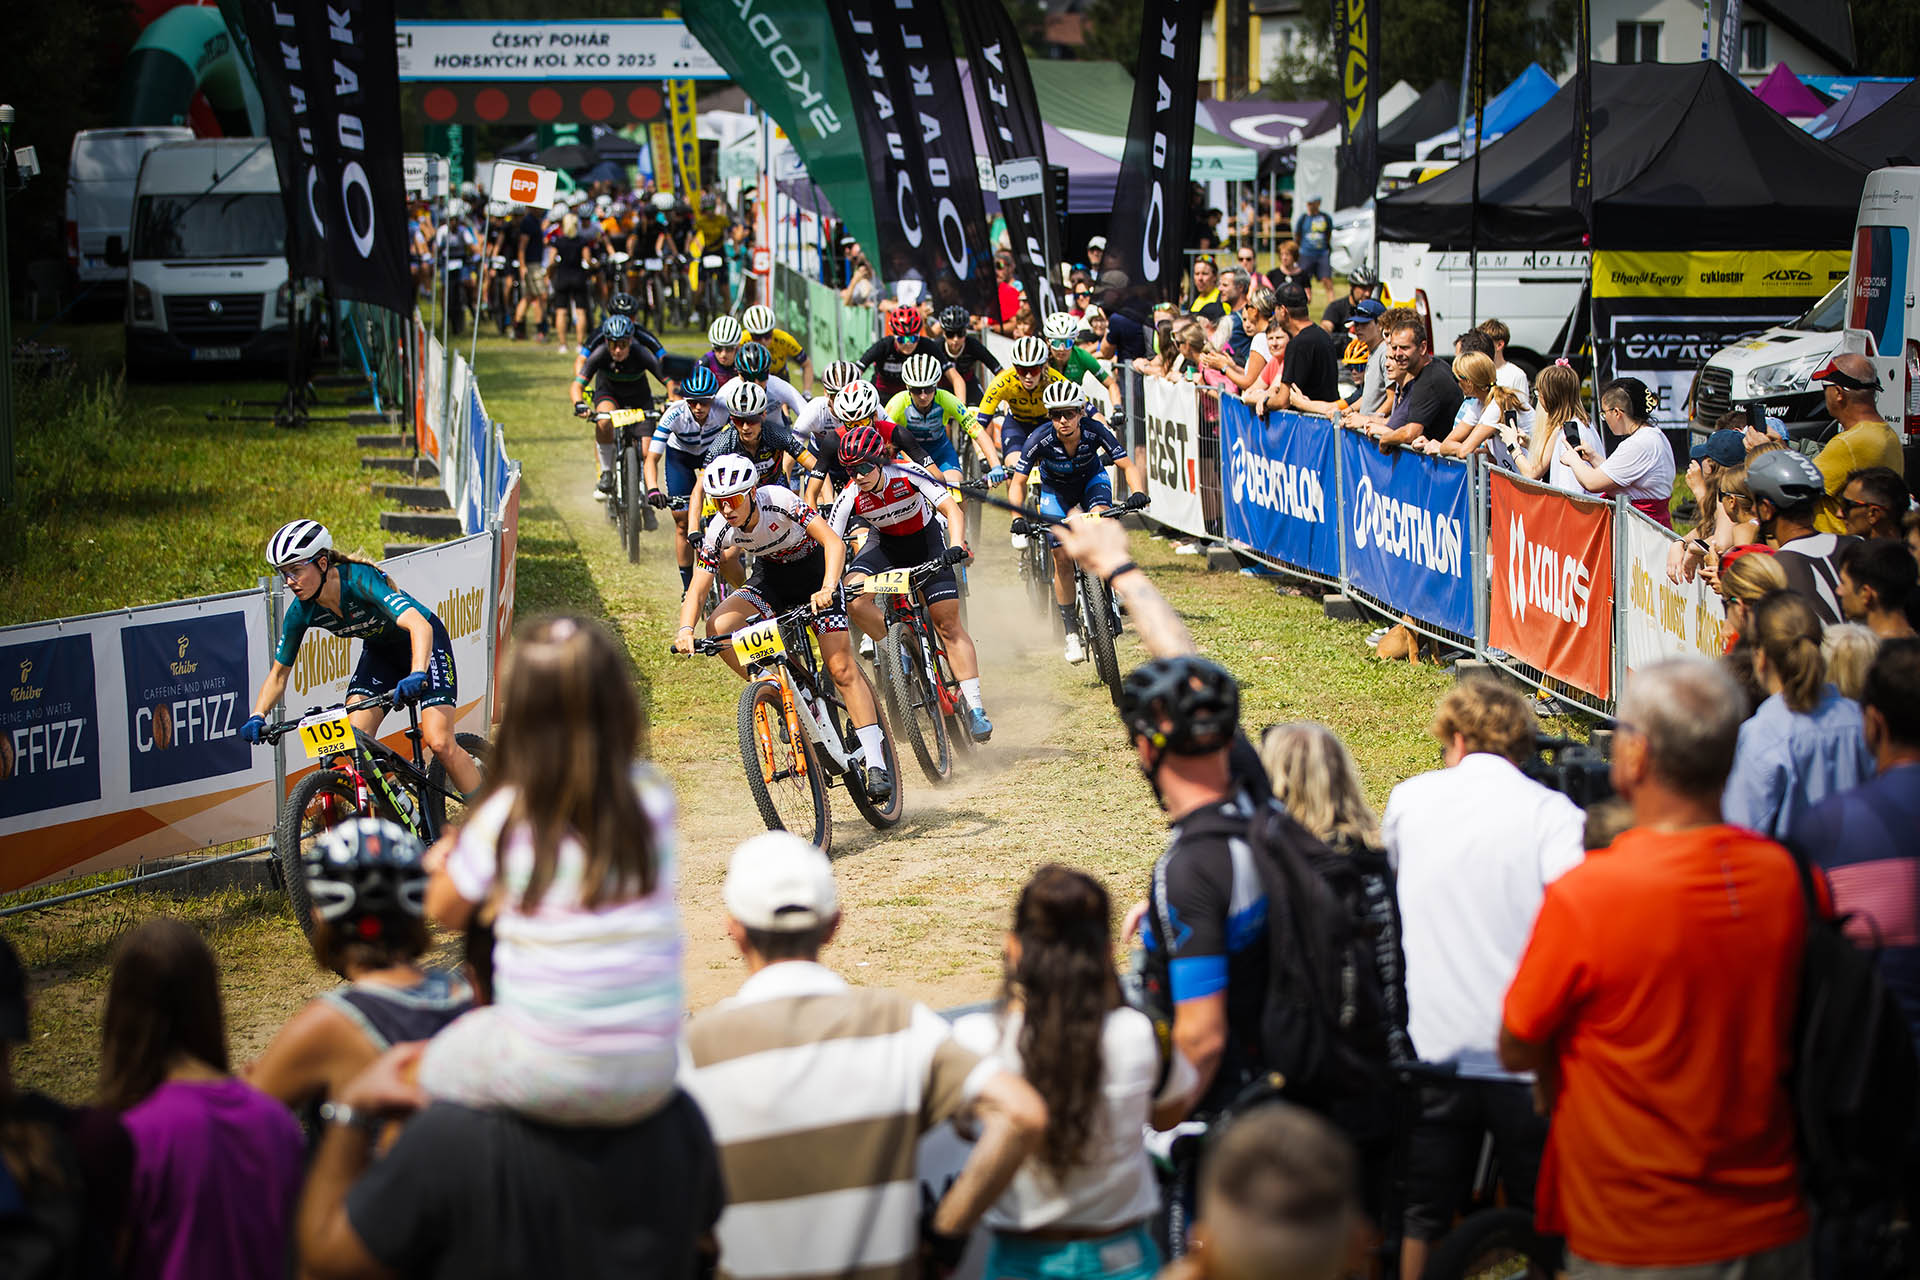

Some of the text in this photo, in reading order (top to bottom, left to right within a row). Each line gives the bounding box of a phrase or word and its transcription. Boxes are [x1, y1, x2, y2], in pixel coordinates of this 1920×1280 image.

[492, 32, 611, 48] ČESKÝ POHÁR
[434, 53, 657, 68] HORSKÝCH KOL XCO 2025
[512, 178, 538, 193] EPP
[1650, 272, 1684, 287] Energy
[1700, 270, 1744, 284] cyklostar
[1246, 450, 1326, 524] DECATHLON
[1372, 490, 1463, 579] DECATHLON
[739, 627, 774, 651] 104
[750, 647, 776, 661] sazka
[170, 660, 198, 676] Tchibo
[294, 629, 352, 697] cyklostar
[11, 685, 43, 702] Tchibo
[144, 676, 226, 700] CAFFEINE AND WATER
[26, 708, 42, 720] AND
[46, 702, 72, 717] WATER
[306, 720, 346, 744] 105
[318, 742, 346, 756] sazka
